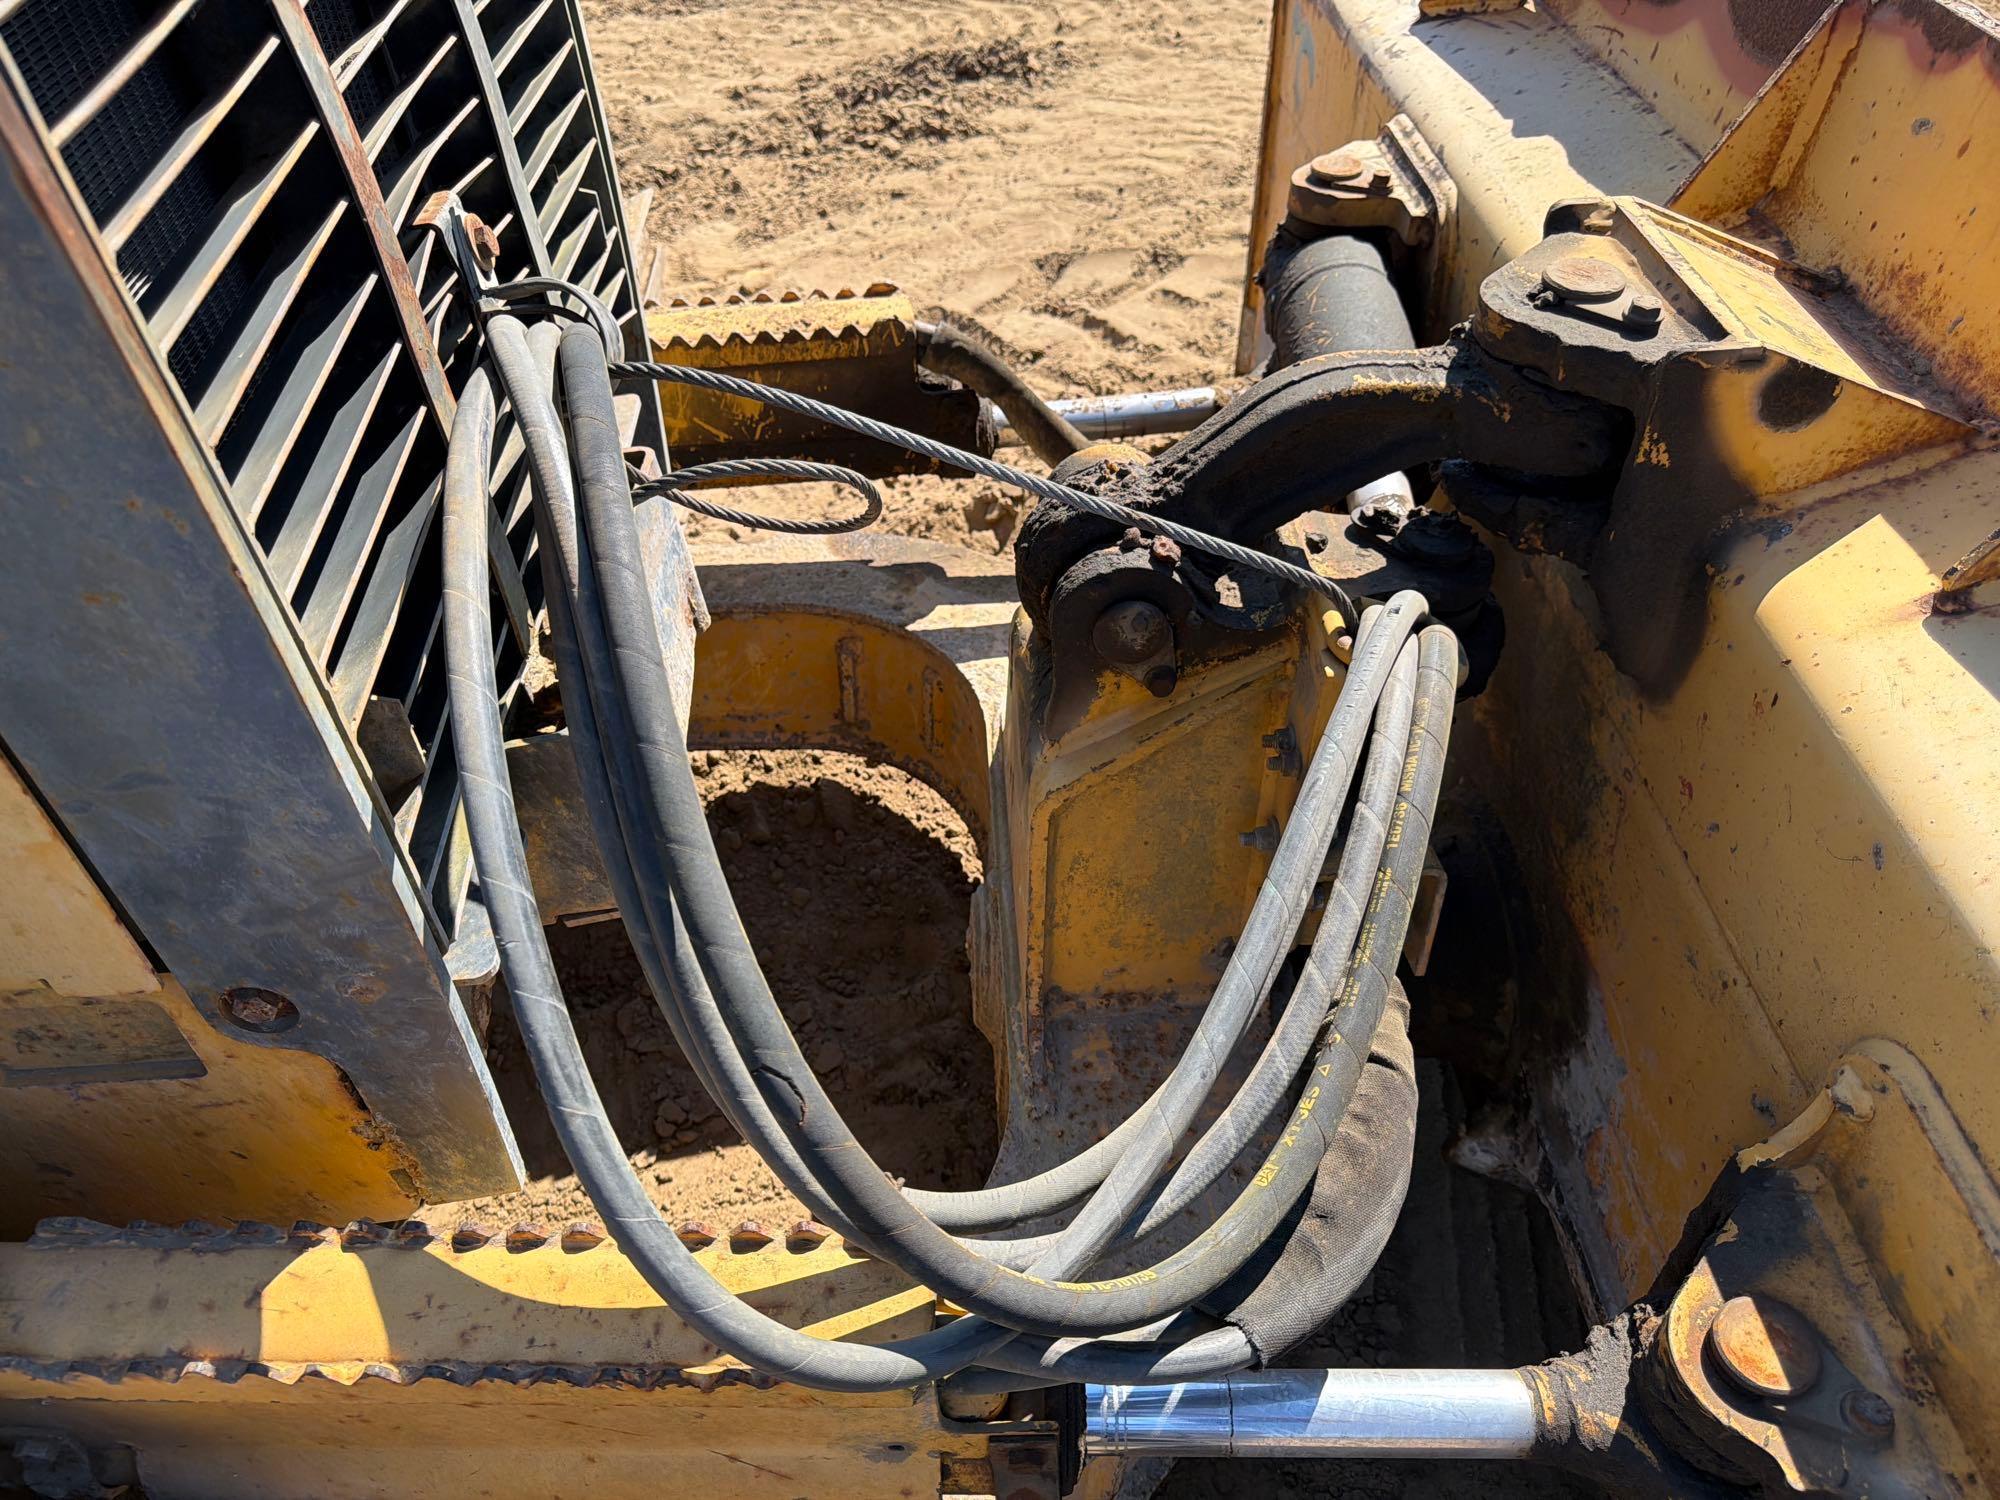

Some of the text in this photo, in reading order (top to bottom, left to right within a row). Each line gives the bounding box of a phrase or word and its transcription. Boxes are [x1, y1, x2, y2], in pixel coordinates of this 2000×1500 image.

[1381, 881, 1391, 898] BAR
[1253, 1162, 1280, 1187] CAT
[1095, 1268, 1158, 1292] IC-101/39
